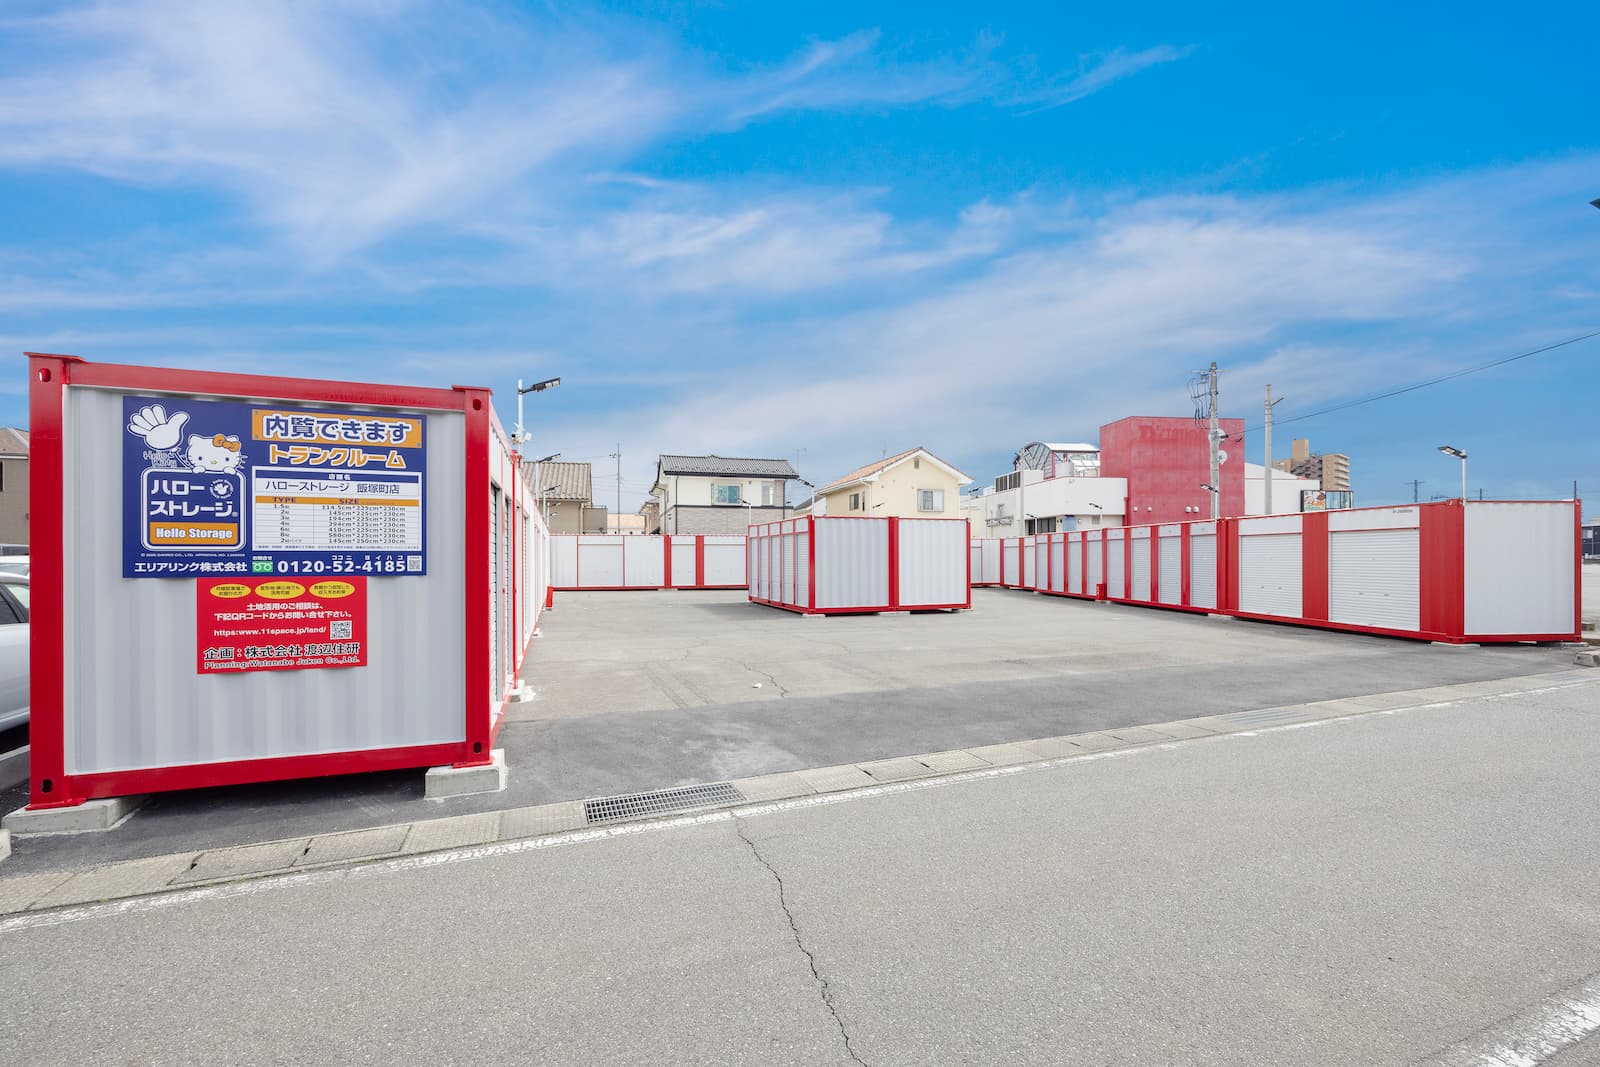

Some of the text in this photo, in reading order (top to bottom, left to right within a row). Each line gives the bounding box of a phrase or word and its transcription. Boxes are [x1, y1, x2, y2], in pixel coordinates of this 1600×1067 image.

[264, 414, 411, 443] 内覧できます
[270, 444, 406, 468] トランクルーム
[151, 478, 205, 495] ハロー
[266, 480, 400, 495] ハローストレージ 飯塚町店
[149, 500, 233, 518] ストレージ
[339, 498, 360, 506] SIZE
[155, 527, 233, 540] Hello Storage
[134, 561, 248, 573] エリアリンク株式会社
[277, 560, 406, 573] 0120-52-4185
[304, 642, 360, 656] 渡辺住研
